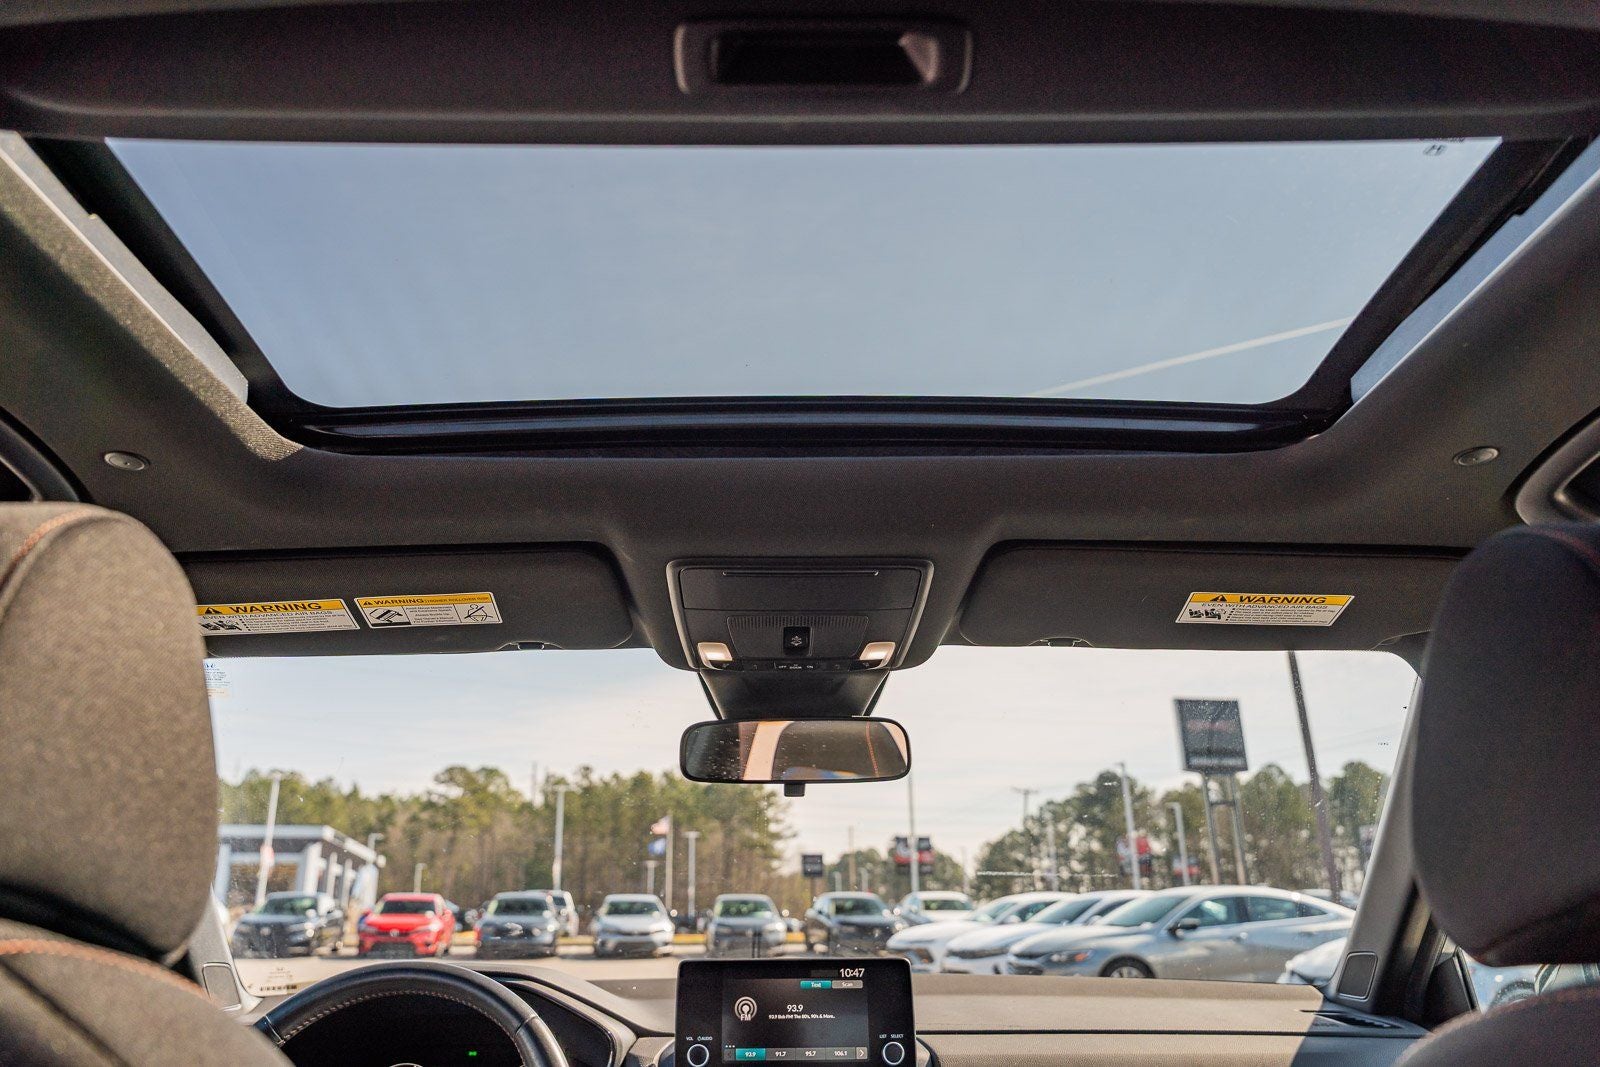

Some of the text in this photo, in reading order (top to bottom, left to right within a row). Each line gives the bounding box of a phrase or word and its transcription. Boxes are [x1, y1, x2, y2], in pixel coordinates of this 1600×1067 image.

[1239, 595, 1327, 604] WARNING
[229, 602, 322, 614] WARNING
[840, 968, 865, 977] 10:47
[786, 1004, 804, 1013] 93.9
[740, 1013, 752, 1021] FM
